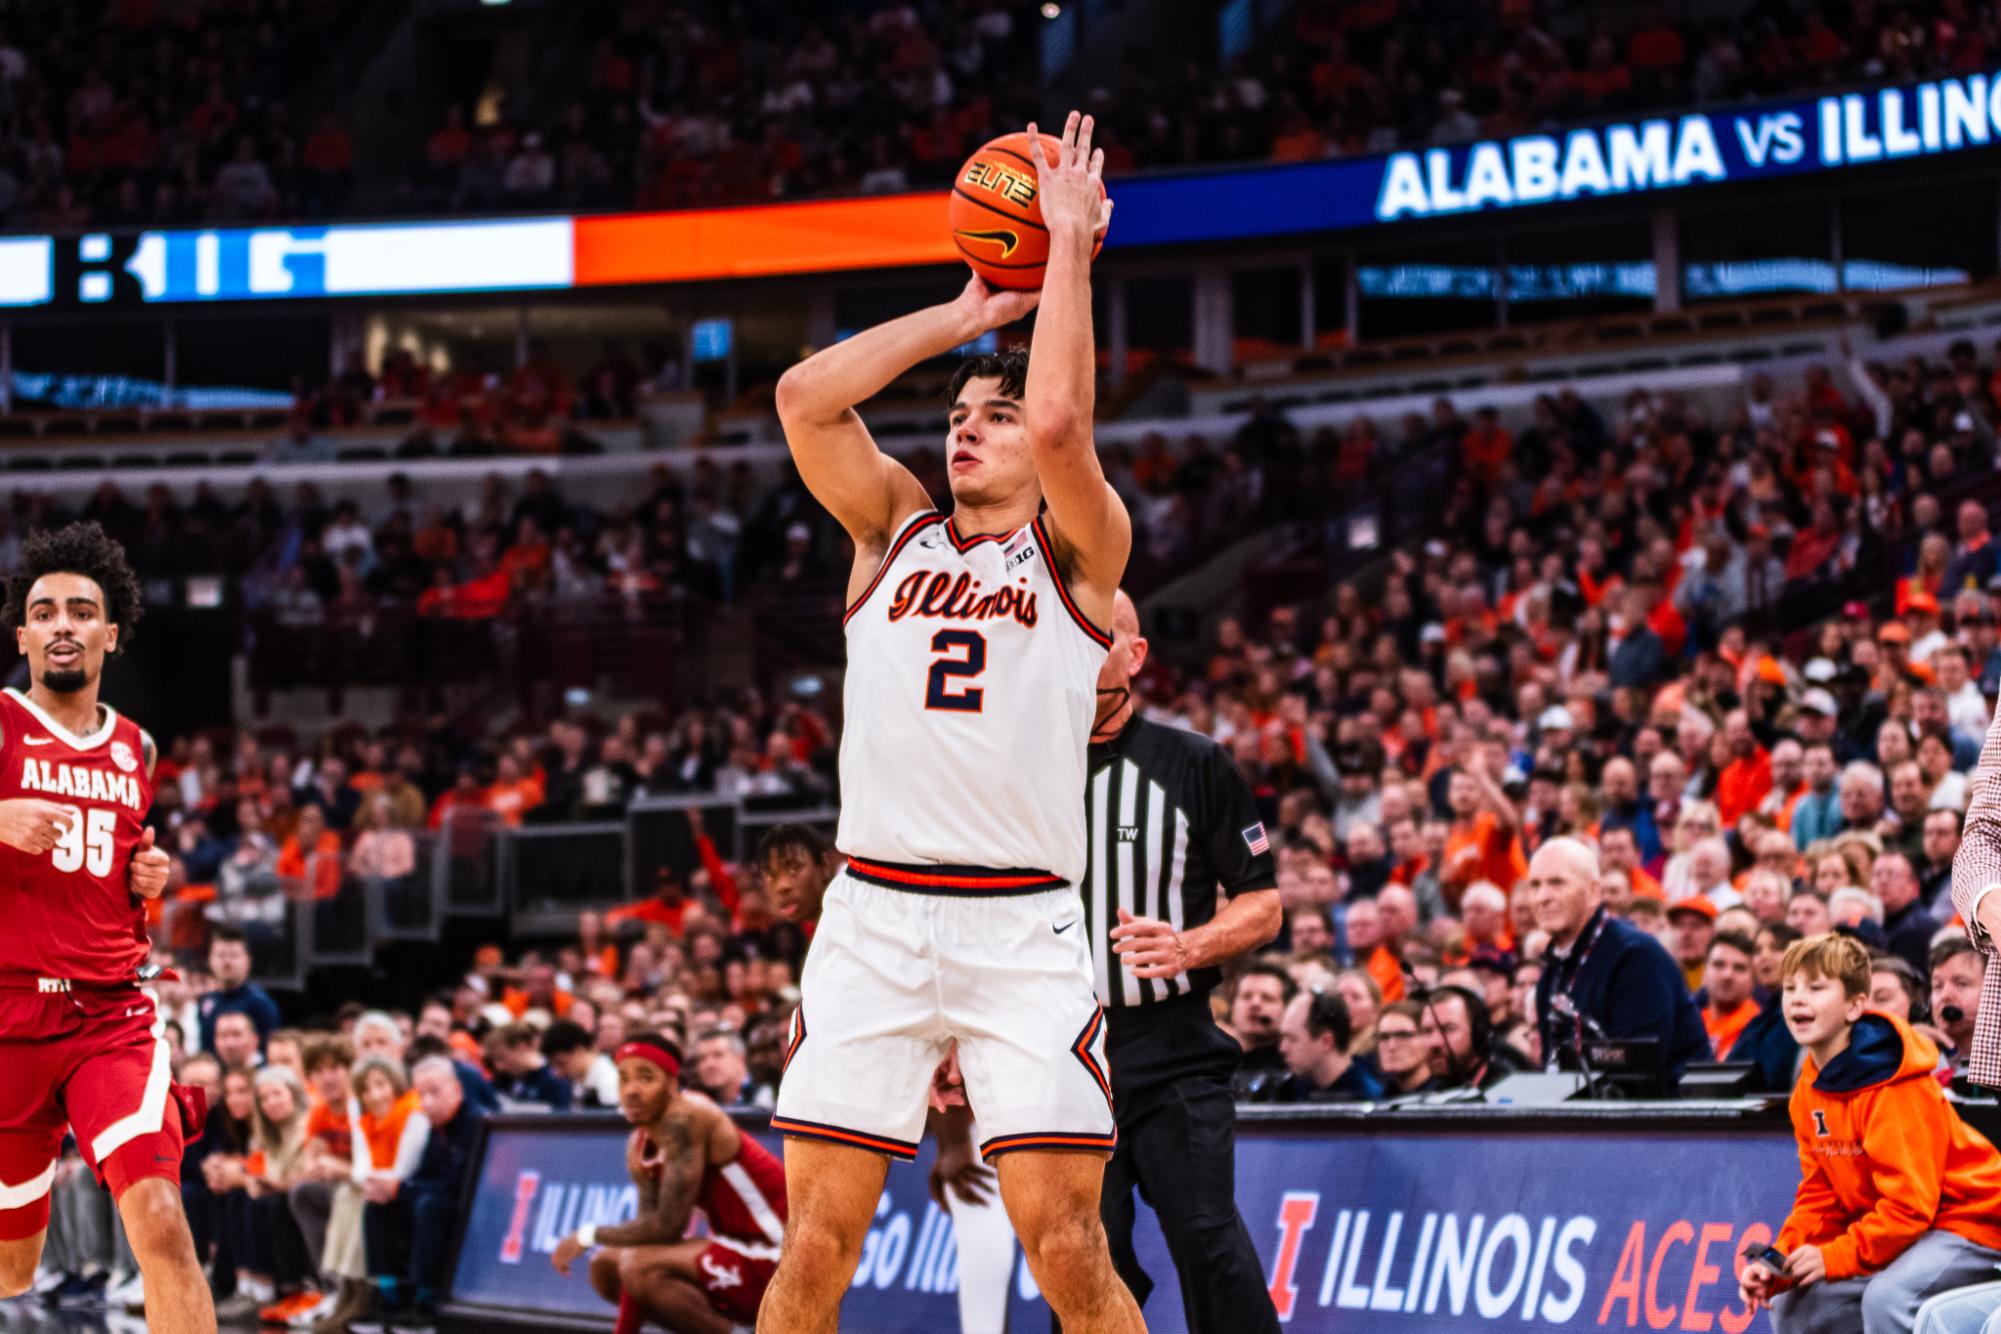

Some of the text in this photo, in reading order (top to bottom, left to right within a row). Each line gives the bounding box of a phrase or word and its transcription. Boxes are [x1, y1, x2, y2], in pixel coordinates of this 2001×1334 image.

[1376, 71, 2001, 223] ALABAMA VS ILLIN
[964, 162, 1037, 209] ELITE
[888, 569, 1038, 629] Illinois
[924, 628, 987, 713] 2
[20, 757, 140, 811] ALABAMA
[51, 804, 117, 878] 95
[1117, 827, 1138, 841] TW
[1812, 1109, 1831, 1138] I
[1318, 1209, 1597, 1323] ILLINOIS
[1597, 1220, 1773, 1334] ACES
